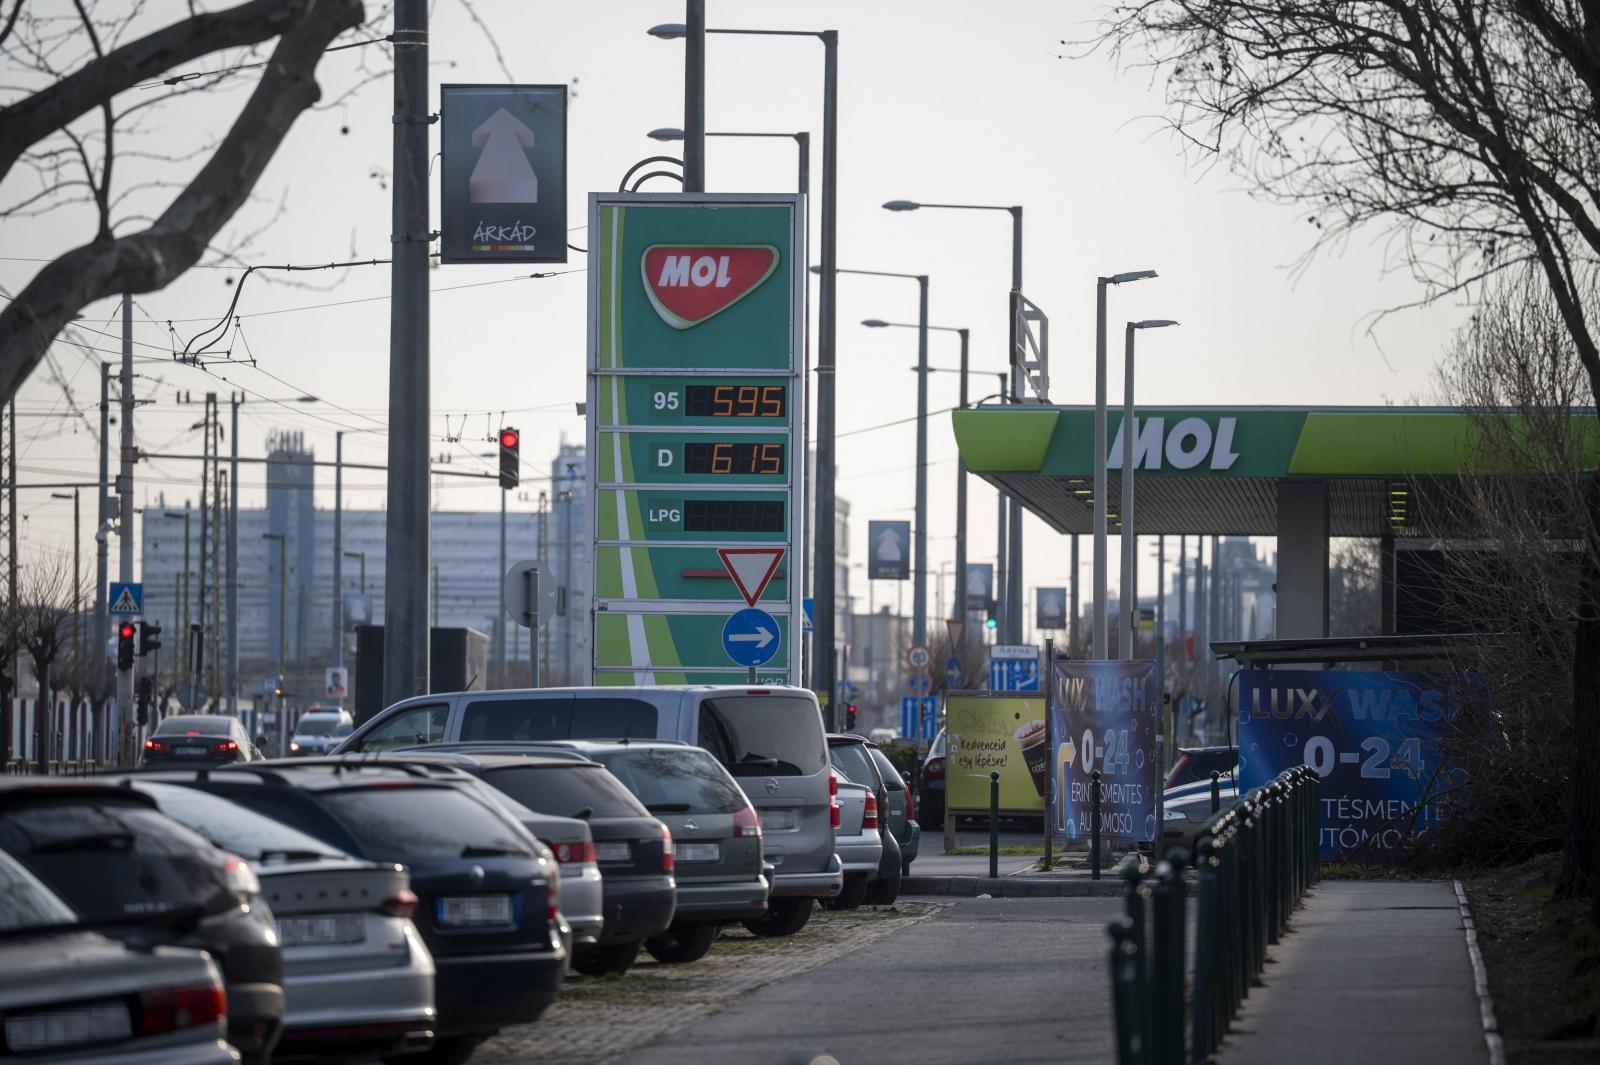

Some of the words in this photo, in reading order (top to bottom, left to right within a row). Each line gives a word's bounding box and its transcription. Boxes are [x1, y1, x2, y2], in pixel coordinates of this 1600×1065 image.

[473, 220, 536, 242] ÁRKÁD
[658, 255, 731, 288] MOL
[654, 391, 679, 410] 95
[713, 386, 783, 416] 595
[1106, 416, 1240, 470] MOL
[658, 449, 673, 467] D
[711, 443, 781, 474] 615
[649, 509, 681, 522] LPG
[1347, 687, 1458, 722] WAS
[960, 739, 1006, 751] Kedvenceid
[1081, 728, 1130, 775] 0-24
[1303, 735, 1425, 780] 0-24
[959, 756, 974, 770] egy
[975, 754, 1008, 769] lépésre!
[1071, 778, 1142, 804] ÉRINSMENTES
[1080, 809, 1133, 834] AUÓMOSÓ
